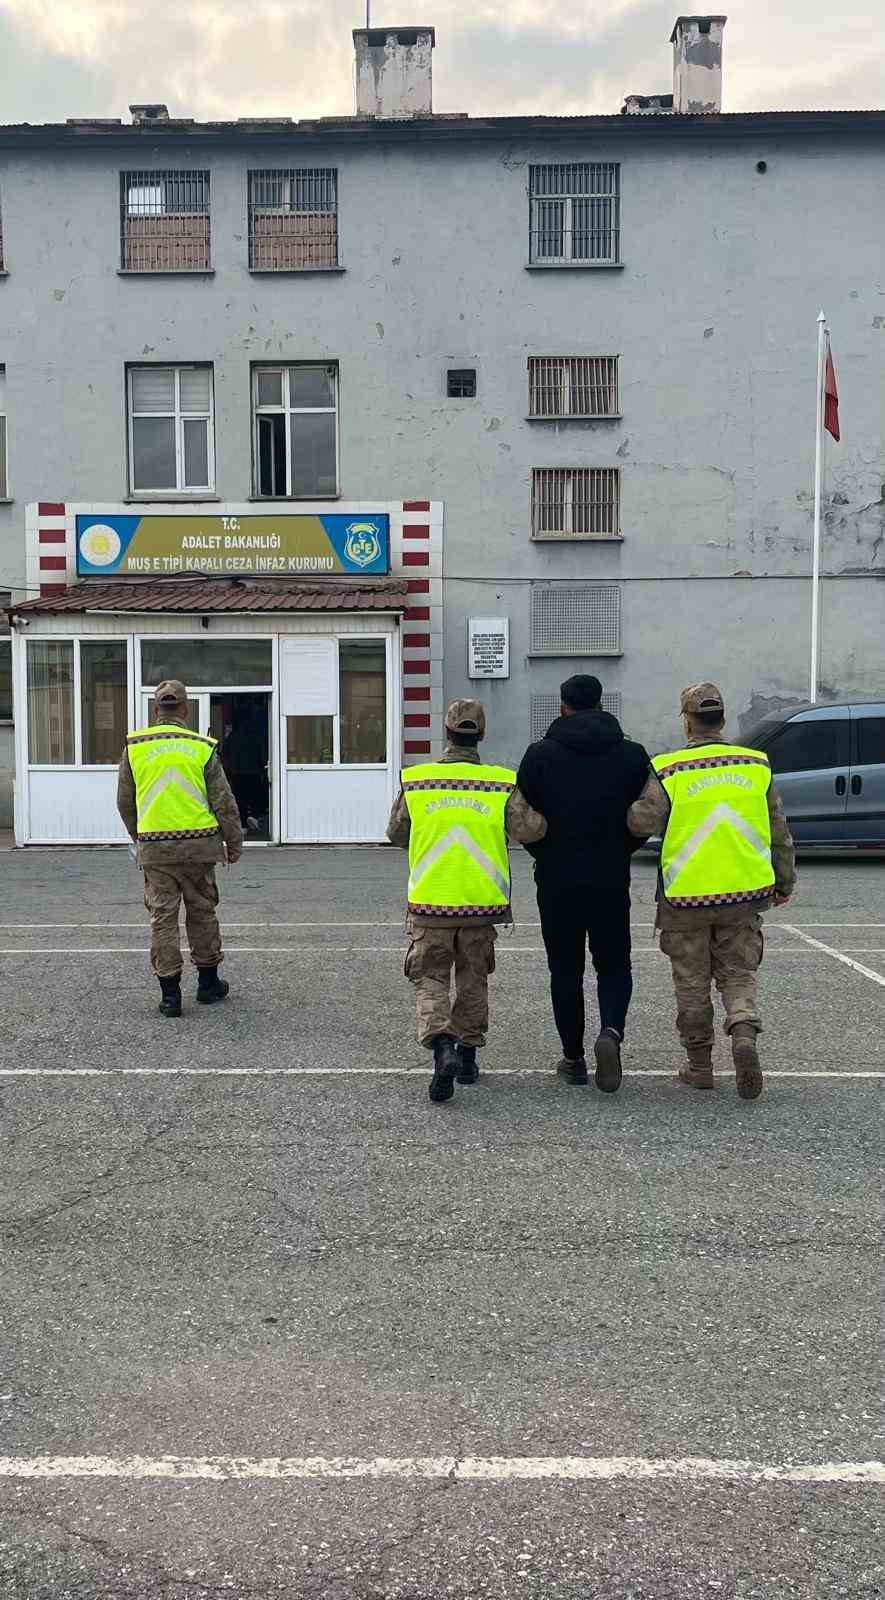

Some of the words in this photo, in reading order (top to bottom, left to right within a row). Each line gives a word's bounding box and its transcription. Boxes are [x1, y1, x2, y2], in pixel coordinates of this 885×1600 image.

[221, 517, 240, 530] T.C.
[181, 535, 222, 549] ADALET
[224, 532, 281, 549] BAKANLIĞI
[127, 557, 151, 571] MUŞ
[153, 557, 160, 570] E
[162, 555, 183, 570] TİPİ
[185, 557, 223, 570] KAPALI
[225, 557, 252, 570] CEZA
[255, 554, 285, 570] İNFAZ
[288, 557, 334, 570] KURUMU
[424, 796, 489, 815] JANDARMA
